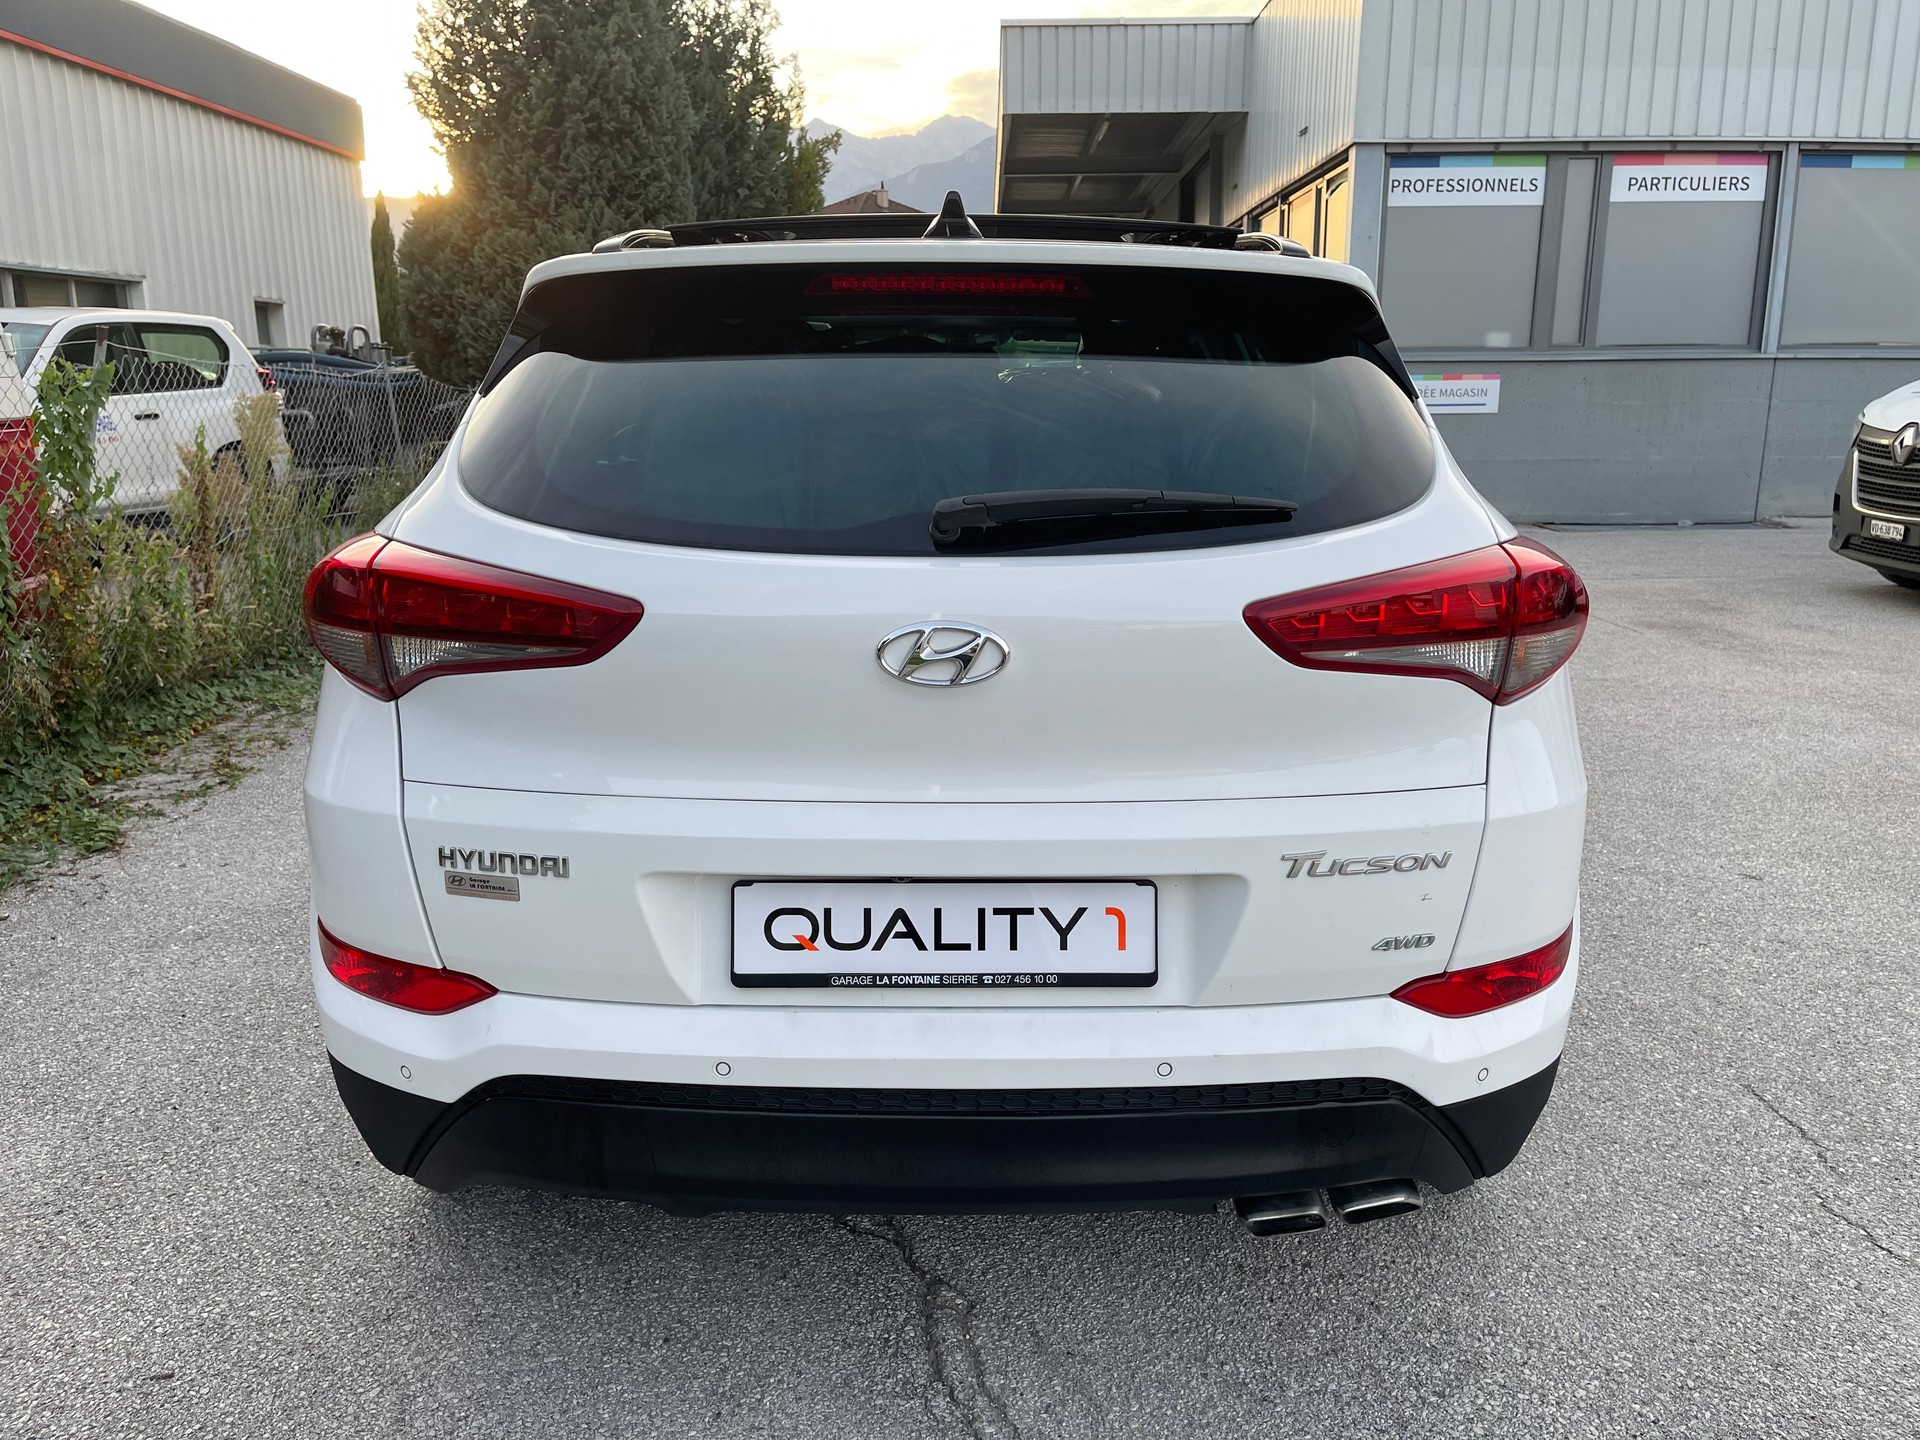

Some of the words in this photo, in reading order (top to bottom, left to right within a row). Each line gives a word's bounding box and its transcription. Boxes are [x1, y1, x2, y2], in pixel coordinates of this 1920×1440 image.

[1391, 178, 1539, 193] PROFESSIONNELS
[1628, 176, 1750, 191] PARTICULIERS
[1440, 388, 1488, 398] MAGASIN
[438, 845, 569, 878] HYUNDAI
[763, 907, 1088, 951] QUALITY
[1105, 906, 1127, 951] 1
[1371, 933, 1436, 951] 4WD
[831, 976, 873, 985] GARAGE
[876, 975, 890, 985] LA
[892, 975, 940, 984] FONTAINE
[942, 975, 978, 984] SIERRE
[994, 975, 1012, 984] 027
[1014, 975, 1031, 984] 456
[1034, 975, 1044, 984] 10
[1046, 974, 1058, 984] 00
